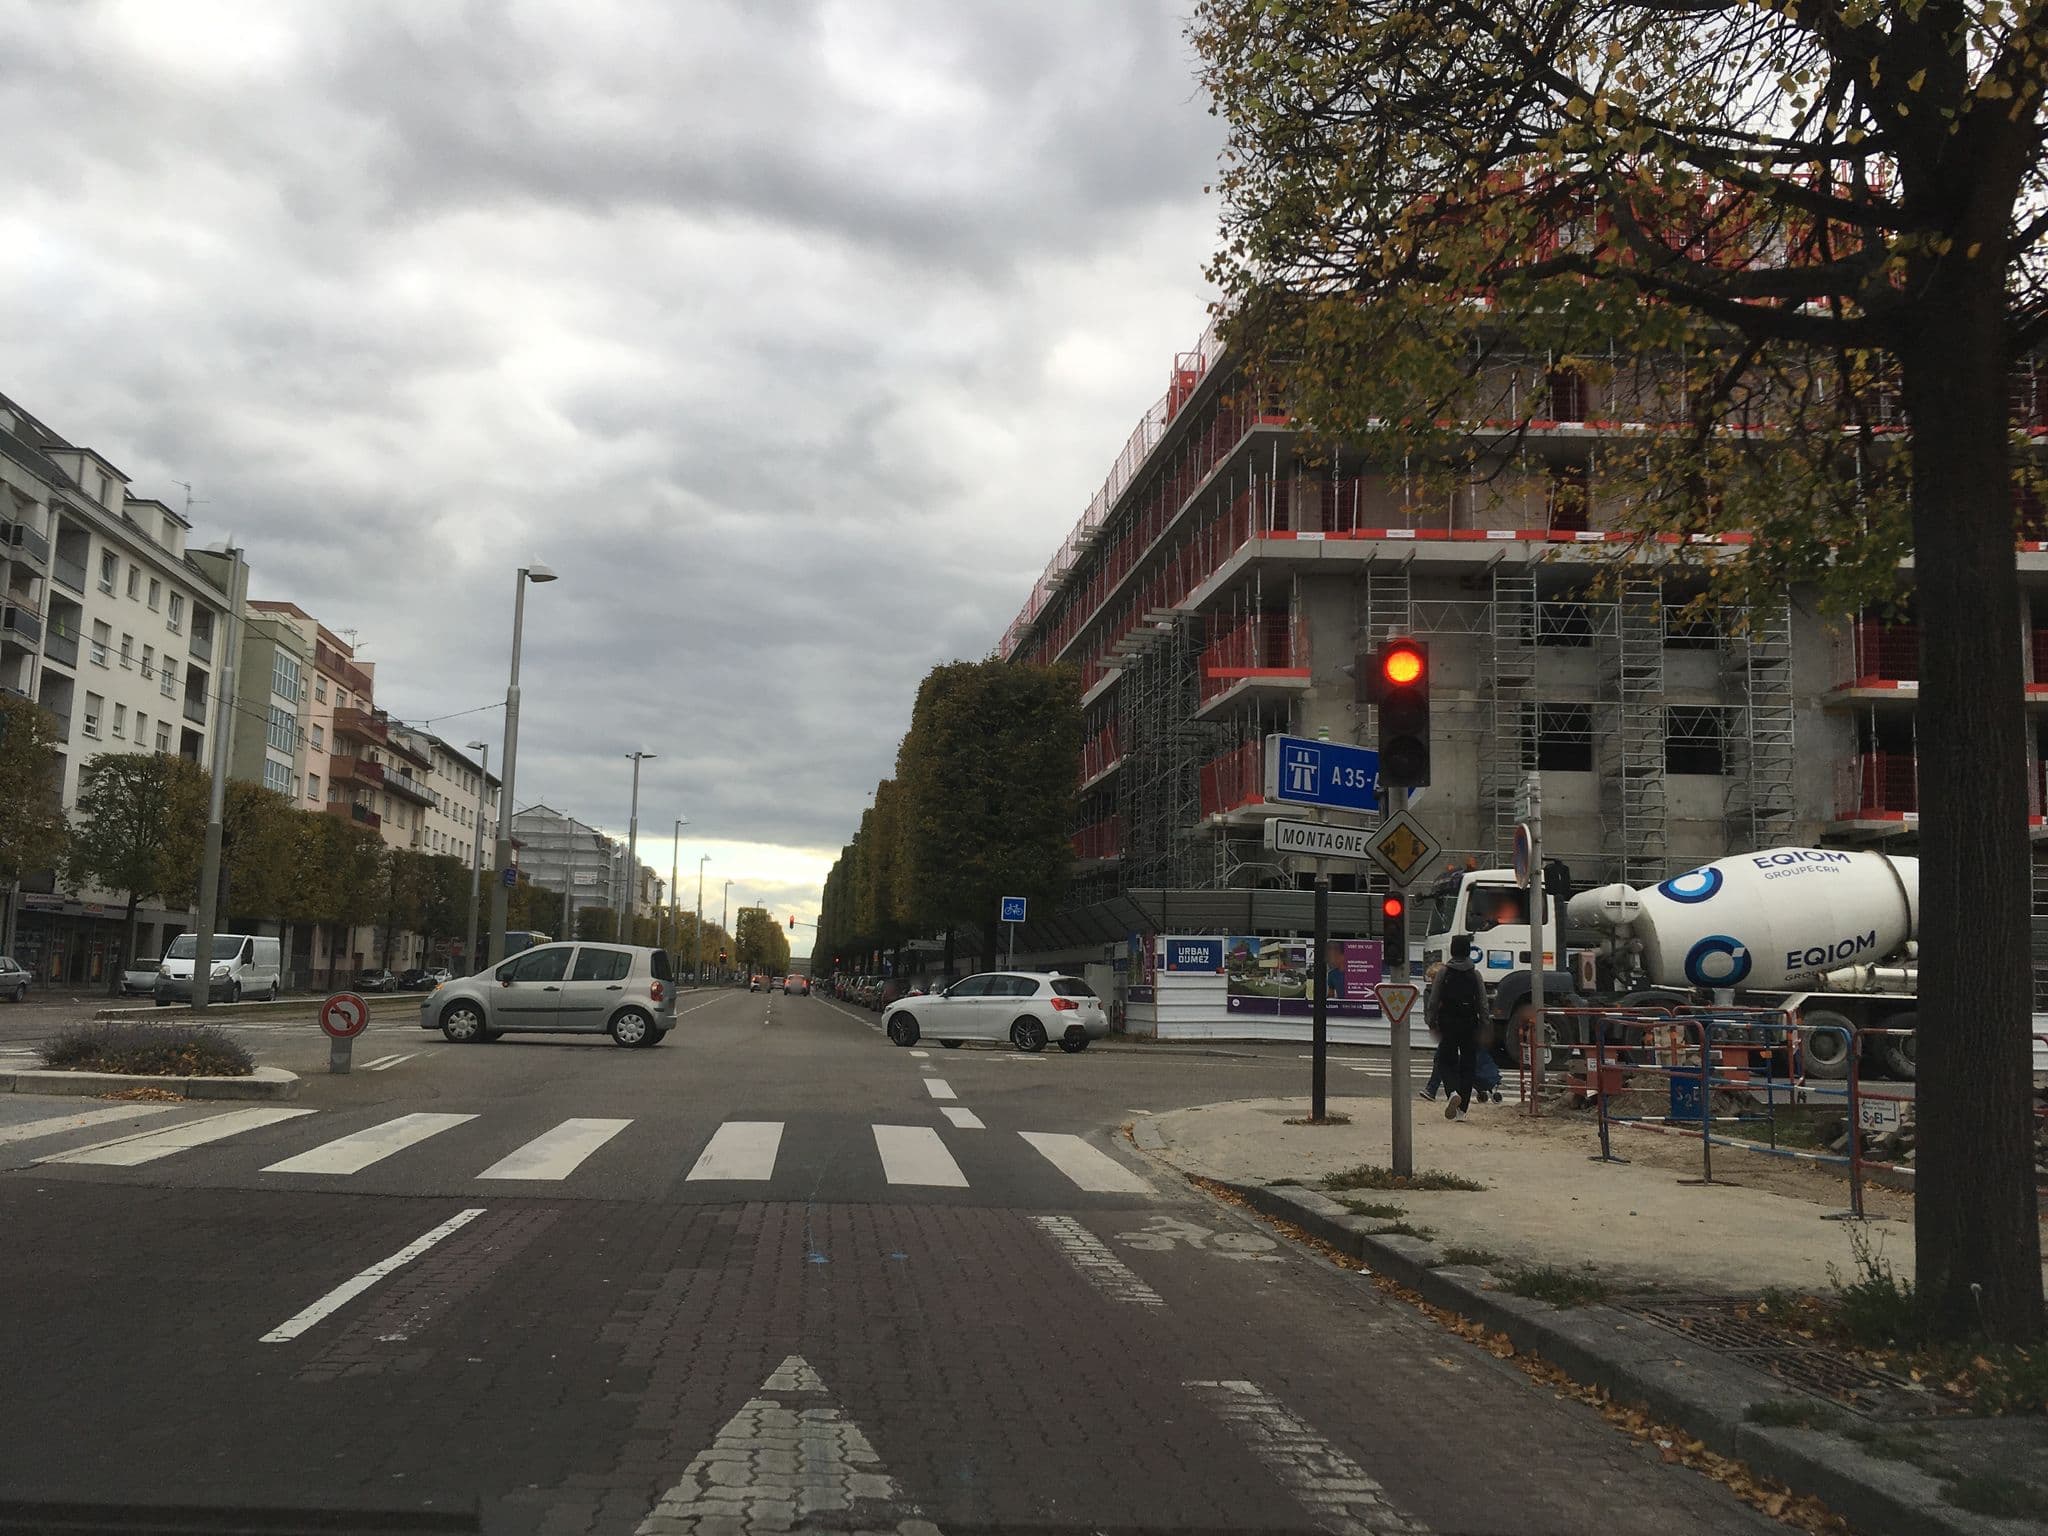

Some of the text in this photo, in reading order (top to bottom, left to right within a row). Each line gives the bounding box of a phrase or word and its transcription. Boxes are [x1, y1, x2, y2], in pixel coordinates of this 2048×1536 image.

[1282, 828, 1363, 852] MONTAGNE
[1752, 851, 1852, 869] EQIOM
[1178, 947, 1209, 955] URBAN
[1786, 929, 1876, 970] EQIOM
[1178, 955, 1209, 964] DUMEZ
